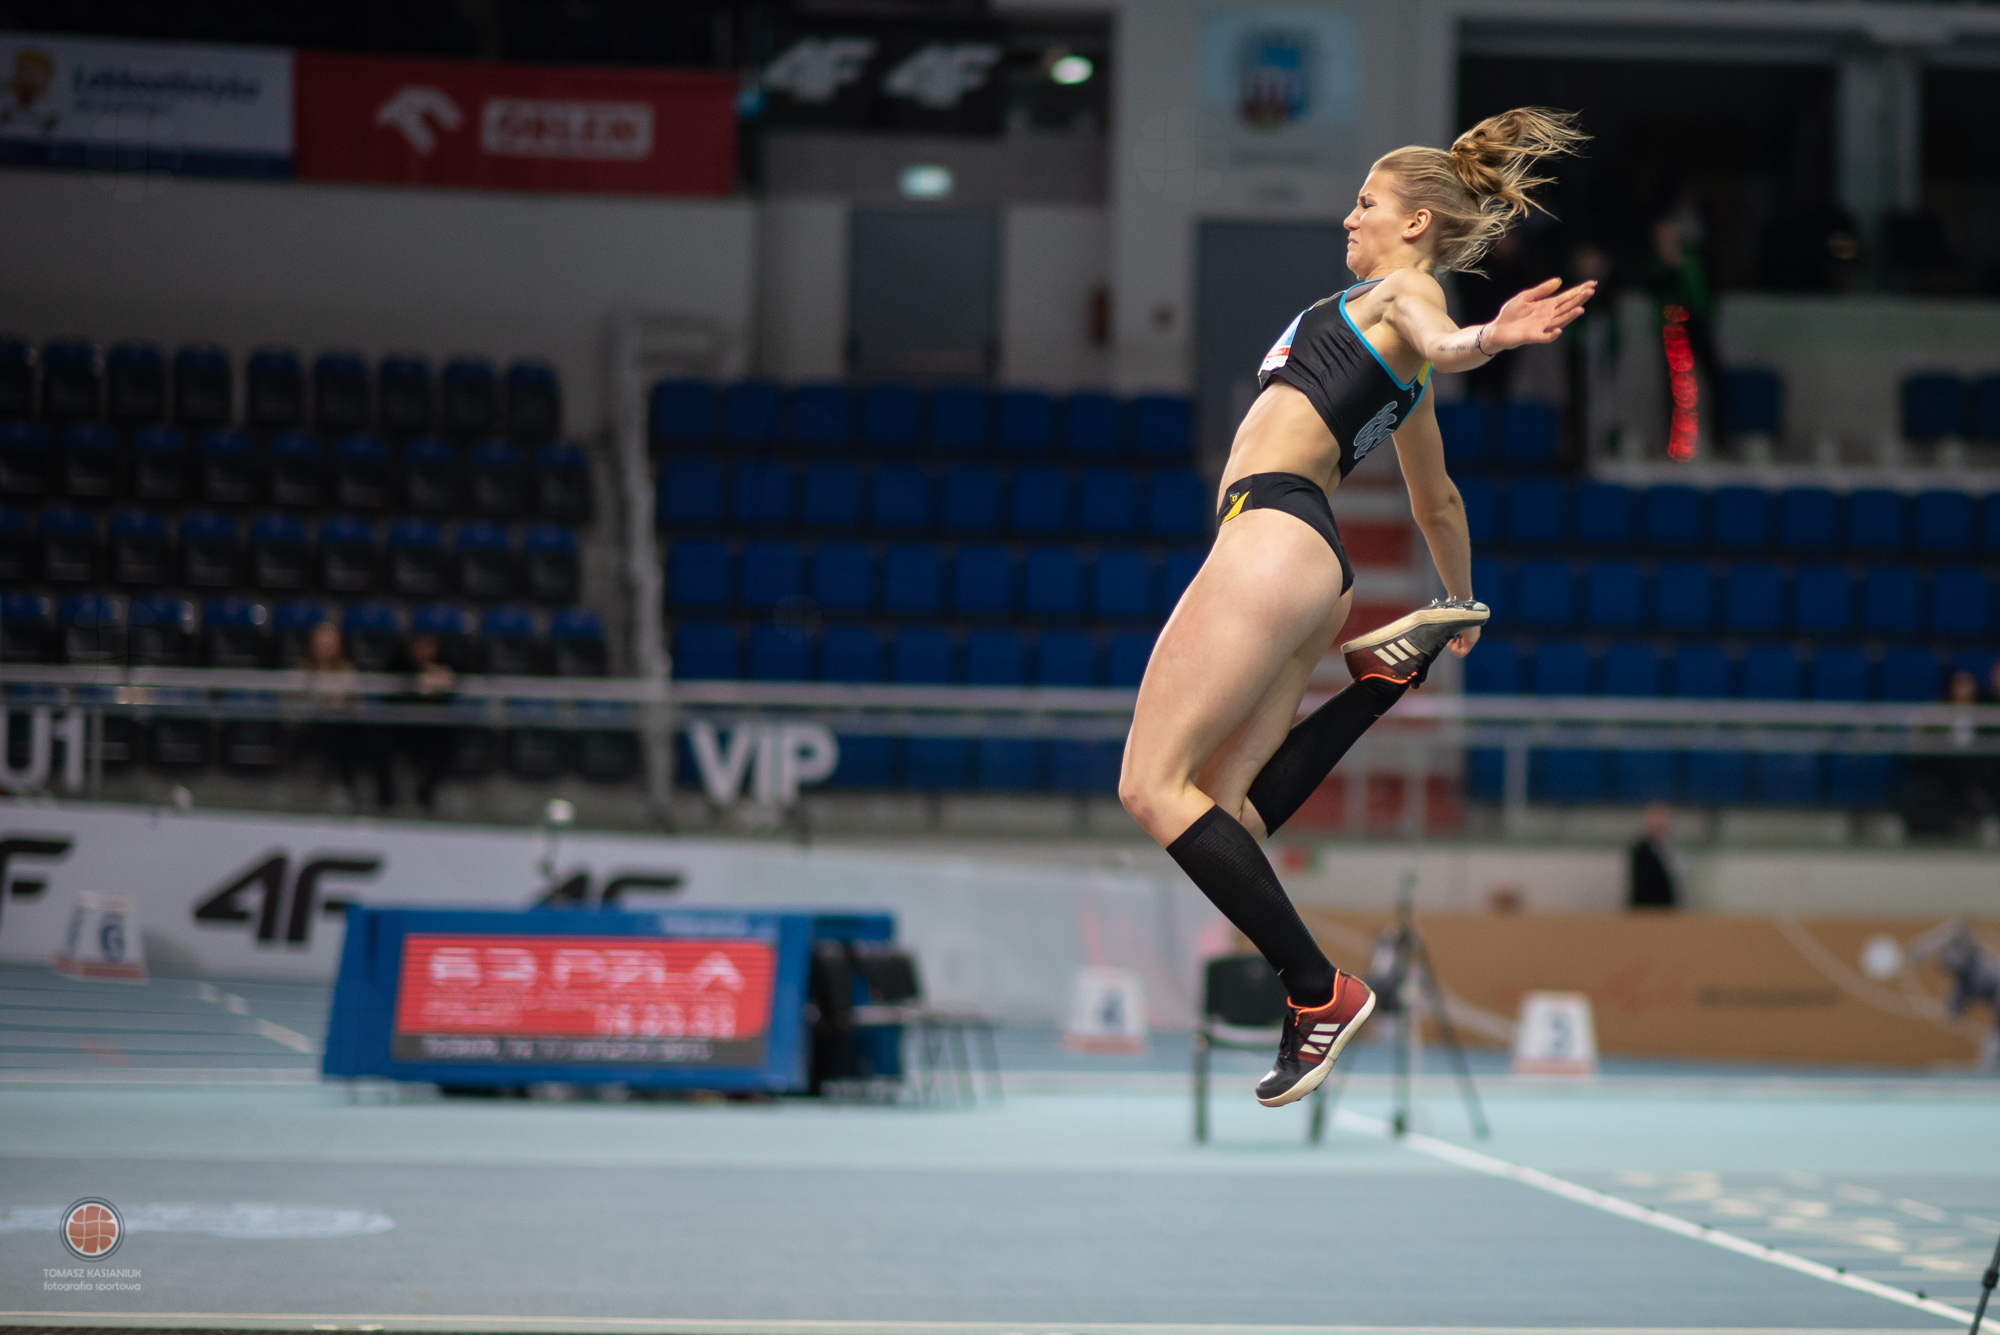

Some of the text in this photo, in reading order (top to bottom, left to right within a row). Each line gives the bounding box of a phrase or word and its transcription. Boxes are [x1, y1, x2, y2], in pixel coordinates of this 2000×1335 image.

[766, 38, 875, 102] 4F
[888, 44, 1001, 108] 4F
[691, 719, 839, 804] VIP
[193, 850, 382, 944] 4F
